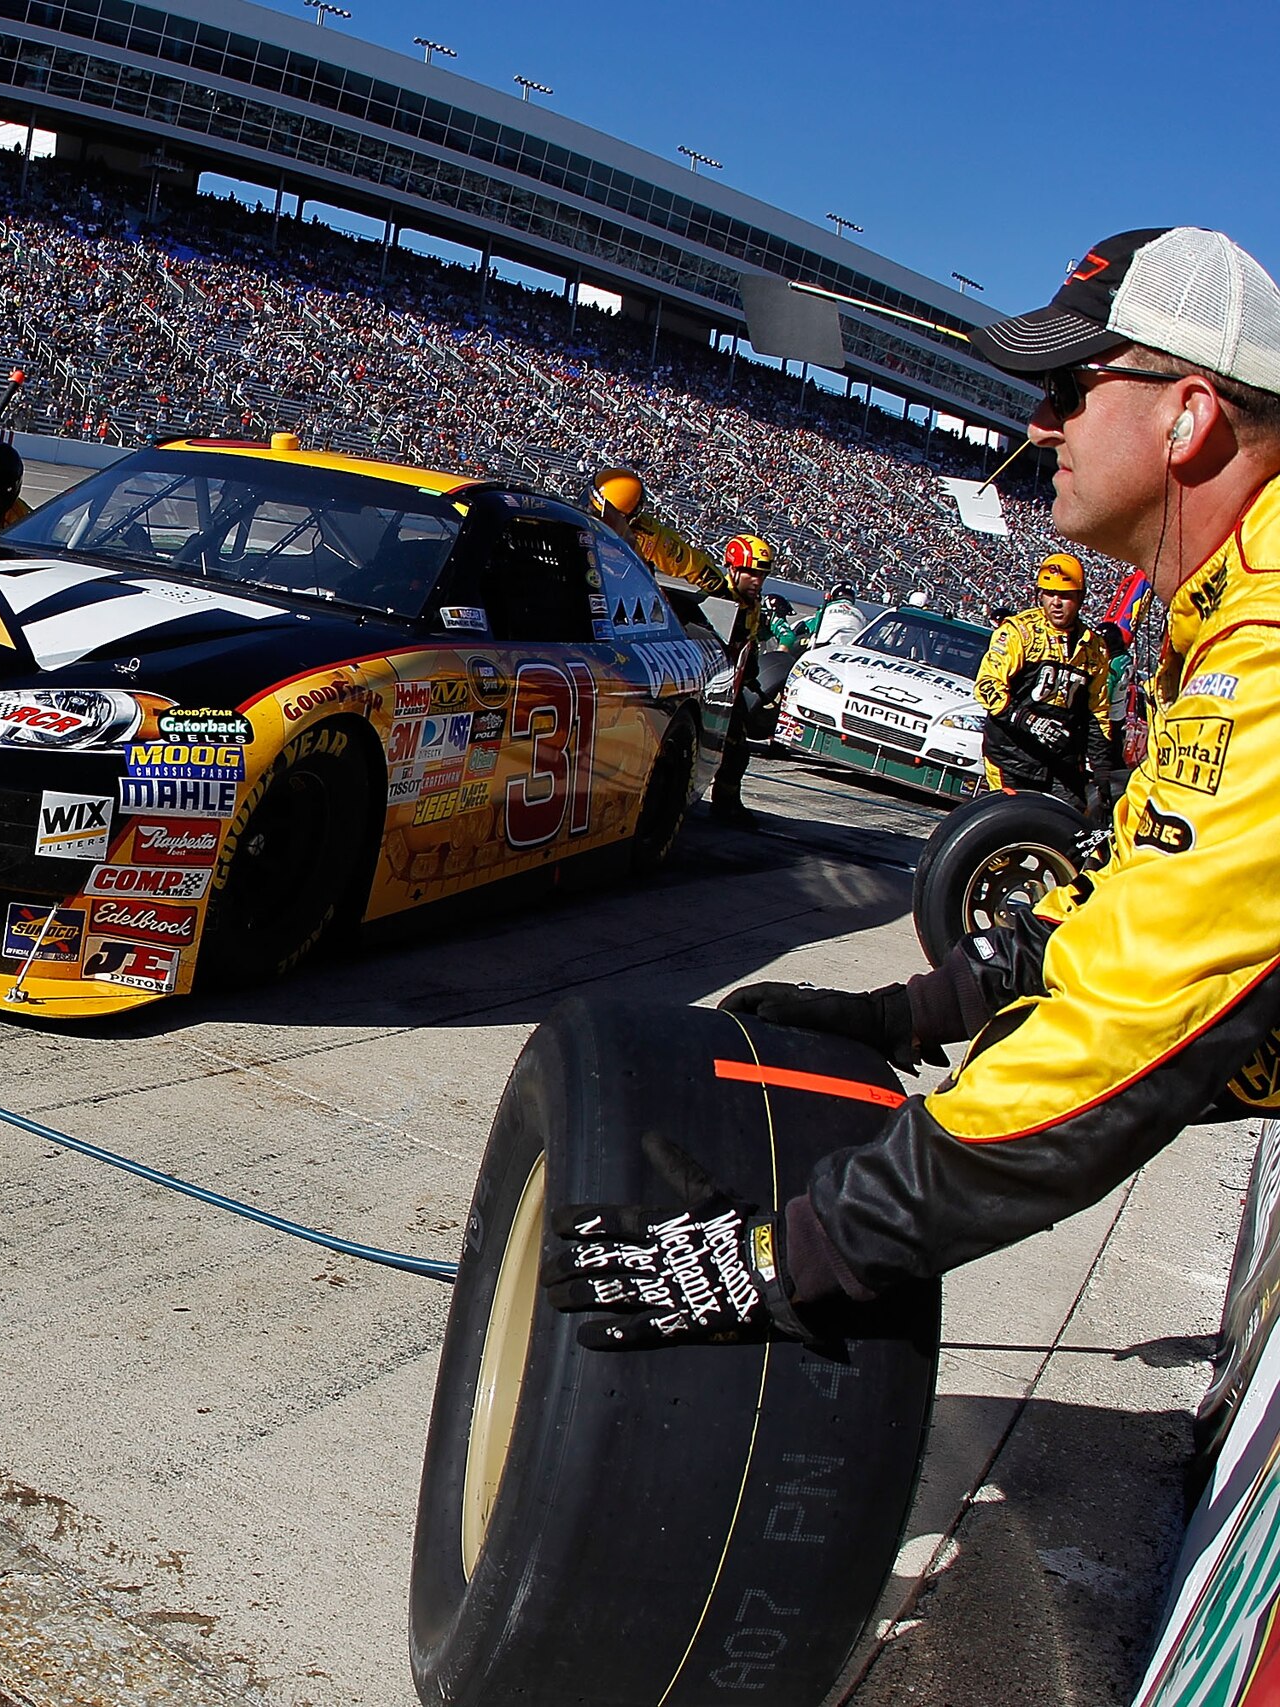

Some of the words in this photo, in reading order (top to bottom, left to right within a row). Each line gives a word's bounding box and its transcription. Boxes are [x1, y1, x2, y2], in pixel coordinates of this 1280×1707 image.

[828, 652, 956, 688] GANDER
[283, 679, 384, 722] GOODYEAR
[395, 683, 430, 713] Holley
[1185, 674, 1237, 700] SCAR
[2, 706, 82, 733] RCR
[160, 717, 246, 734] Gatorback
[169, 707, 233, 718] GOODYEAR
[844, 699, 929, 734] IMPALA
[169, 734, 246, 744] BELTS
[388, 720, 422, 762] 3M
[475, 731, 497, 739] POLE
[129, 745, 241, 767] MOOG
[505, 661, 598, 850] 31
[136, 767, 192, 777] CHASSIS
[201, 769, 238, 780] PARTS
[420, 771, 462, 789] CRAFTSMAN
[121, 779, 235, 812] MAHLE
[389, 779, 421, 797] TISSOT
[42, 799, 111, 835] WIX
[38, 836, 106, 853] FILTERS
[138, 825, 217, 855] Raybestos
[93, 867, 184, 891] COMP
[152, 887, 193, 896] CAMS
[93, 903, 192, 936] Edelbrock
[83, 941, 176, 981] JE
[110, 973, 173, 992] PISTONS
[648, 1211, 721, 1325] Mechanix
[695, 1208, 760, 1324] Mechanix
[708, 1588, 801, 1690] A07
[763, 1452, 846, 1544] PN
